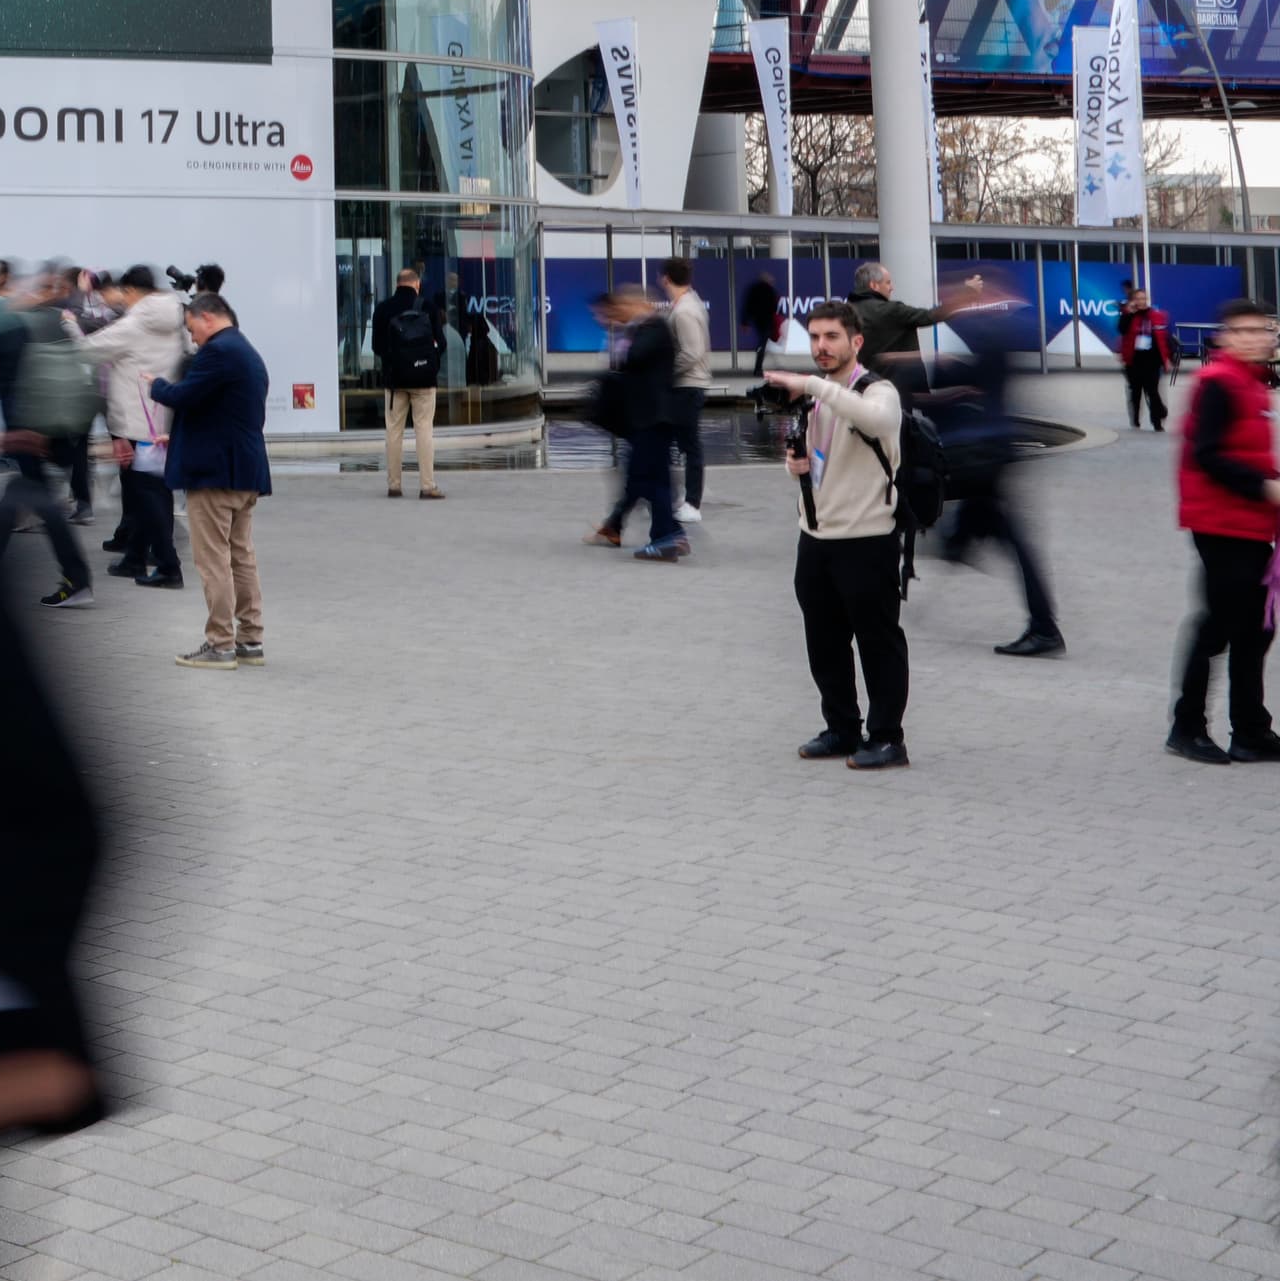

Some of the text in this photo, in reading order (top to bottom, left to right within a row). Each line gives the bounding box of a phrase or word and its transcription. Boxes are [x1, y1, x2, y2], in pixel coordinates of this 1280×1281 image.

[1197, 14, 1238, 26] BARCELONA
[1082, 55, 1107, 168] Galaxy AI
[140, 109, 179, 144] 17
[195, 110, 286, 147] Ultra
[263, 162, 286, 172] WITH
[1060, 298, 1123, 316] MWC
